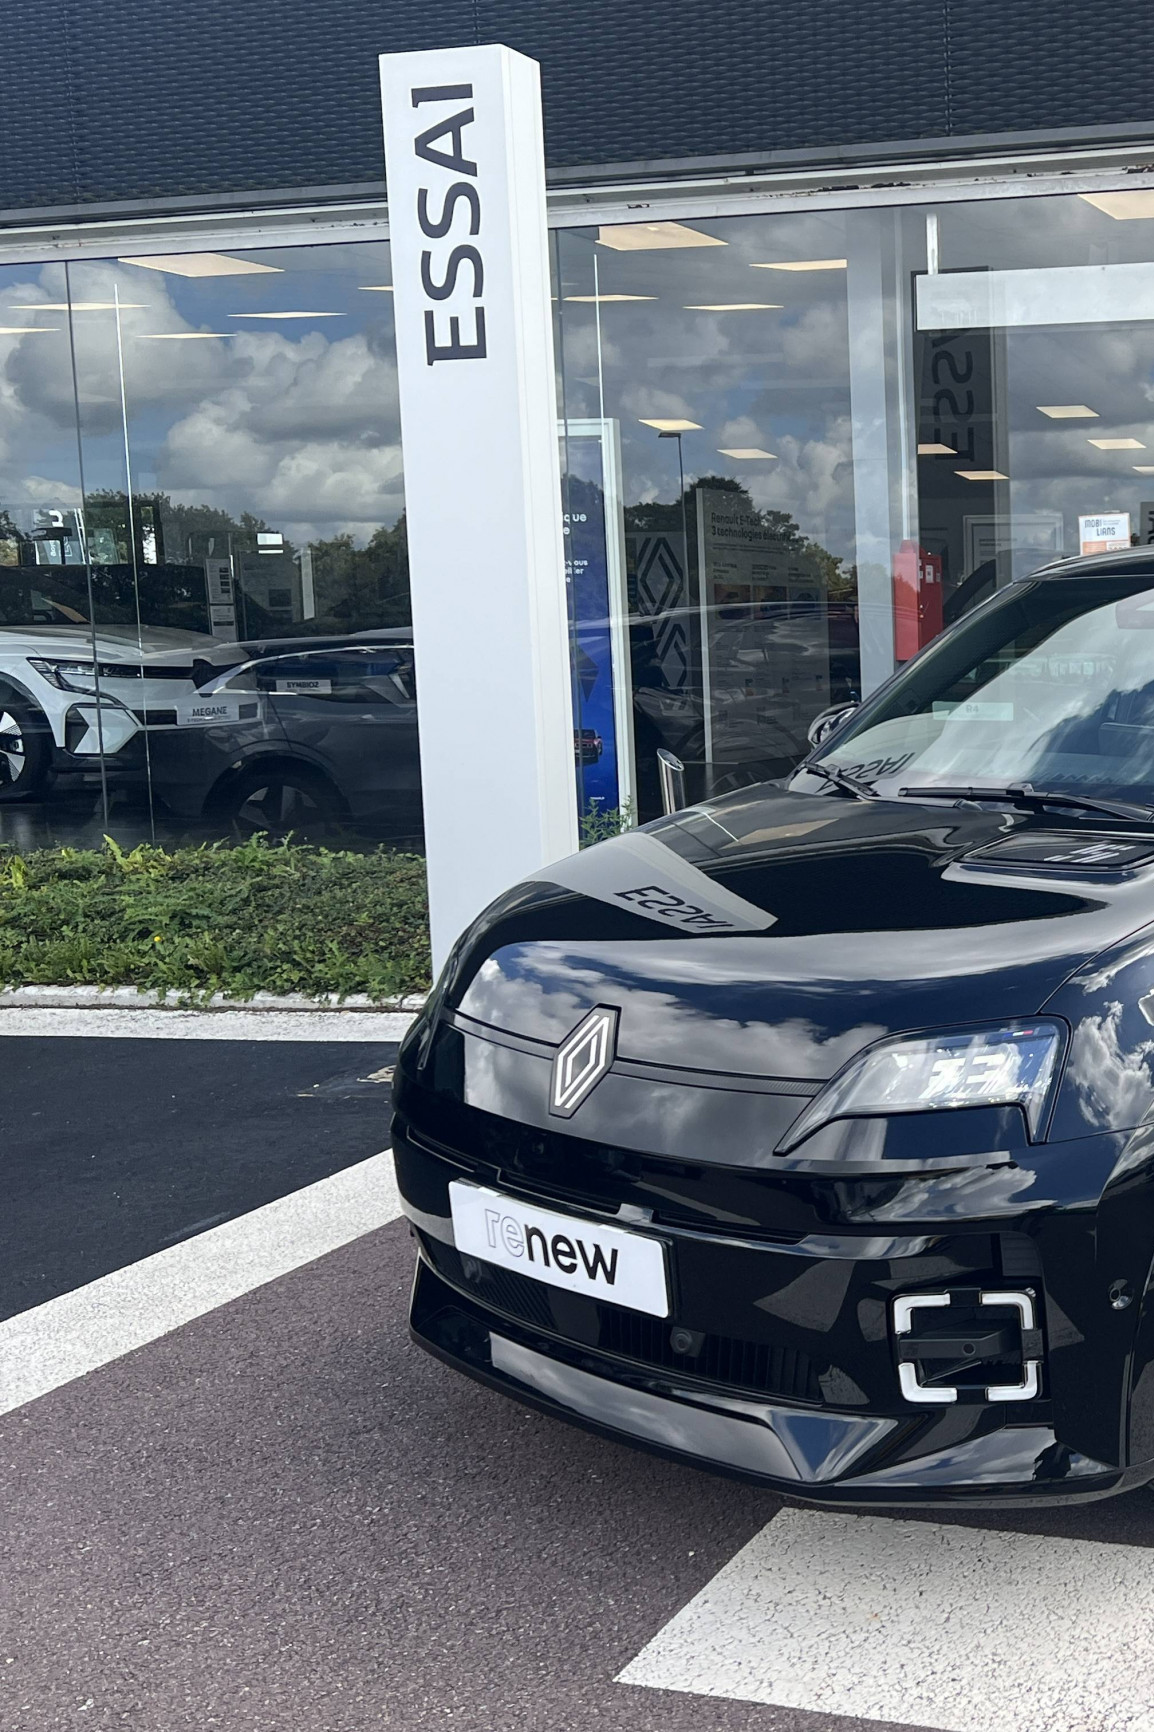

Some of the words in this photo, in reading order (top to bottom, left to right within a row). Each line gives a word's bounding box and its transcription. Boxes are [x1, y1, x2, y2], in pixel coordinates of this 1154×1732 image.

[411, 82, 487, 367] ESSAI
[711, 511, 738, 525] Renault
[717, 527, 762, 542] technologies
[286, 681, 320, 689] SYMBIOZ
[192, 706, 228, 717] MEGANE
[484, 1208, 618, 1285] renew
